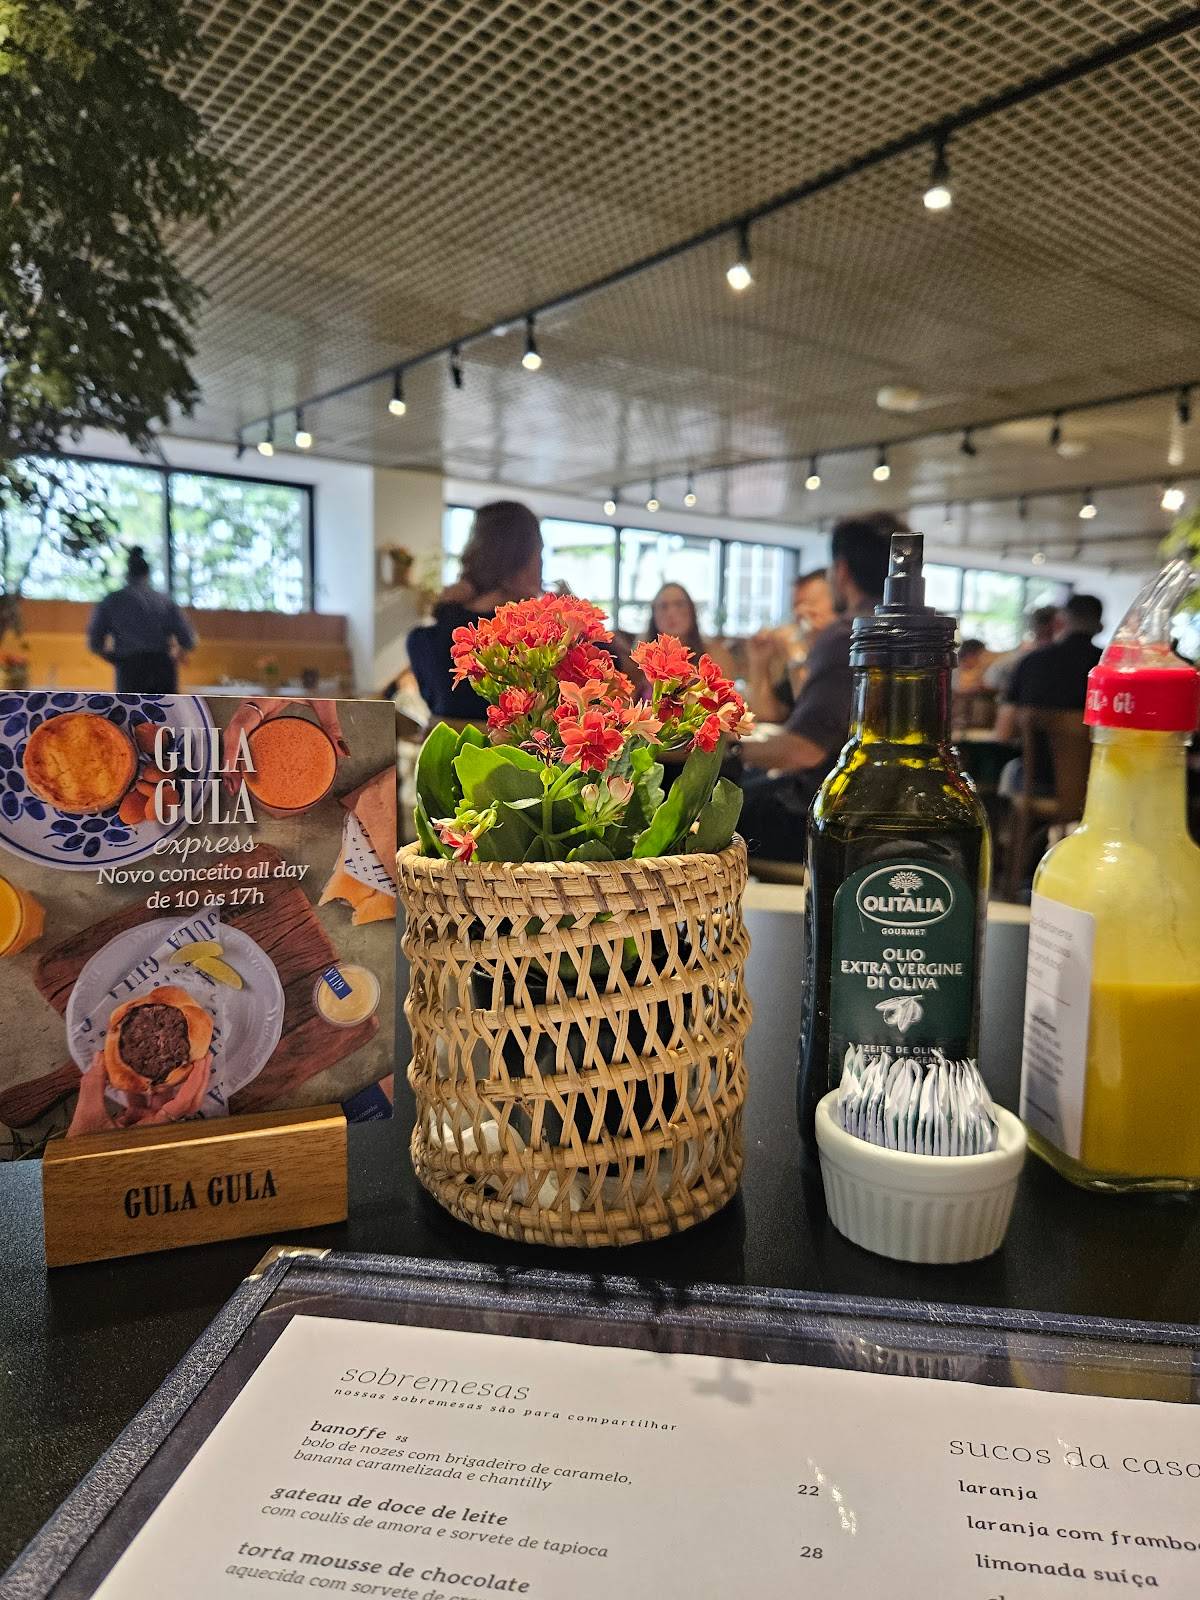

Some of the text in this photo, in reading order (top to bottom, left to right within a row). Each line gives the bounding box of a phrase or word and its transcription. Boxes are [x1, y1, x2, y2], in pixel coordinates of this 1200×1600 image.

[154, 726, 256, 774] GULA
[154, 778, 256, 826] GULA
[153, 835, 258, 863] express
[96, 860, 310, 886] Novo conceito all day
[146, 886, 265, 910] de 10 às 17h
[863, 895, 946, 913] OLITALIA
[881, 927, 926, 936] GOURMET
[840, 960, 963, 976] EXTRA VERGINE
[882, 948, 924, 962] OLIO
[866, 976, 938, 990] DI OLIVA
[895, 1045, 909, 1054] DE
[123, 1169, 278, 1219] GULA GULA
[340, 1366, 531, 1401] sobremesas
[334, 1388, 679, 1432] nossas sobremesas são para compartilhar
[310, 1420, 388, 1441] banoffe
[294, 1448, 553, 1492] banana caramelizada e chantilly
[301, 1436, 633, 1486] bolo de nozes com brigadeiro de caramelo,
[949, 1438, 1200, 1479] sucos da casa
[797, 1484, 820, 1497] 22
[959, 1479, 1038, 1500] laranja
[270, 1485, 509, 1527] gateau de doce de leite
[261, 1502, 609, 1559] com coulis de amora e sorvete de tapioca
[967, 1515, 1049, 1537] laranja
[1056, 1526, 1104, 1542] com
[800, 1545, 823, 1559] 28
[225, 1562, 305, 1587] aquecida
[309, 1573, 346, 1592] com
[351, 1582, 419, 1600] sorvete
[237, 1540, 531, 1594] torta mousse de chocolate
[976, 1554, 1159, 1588] limonada suíça
